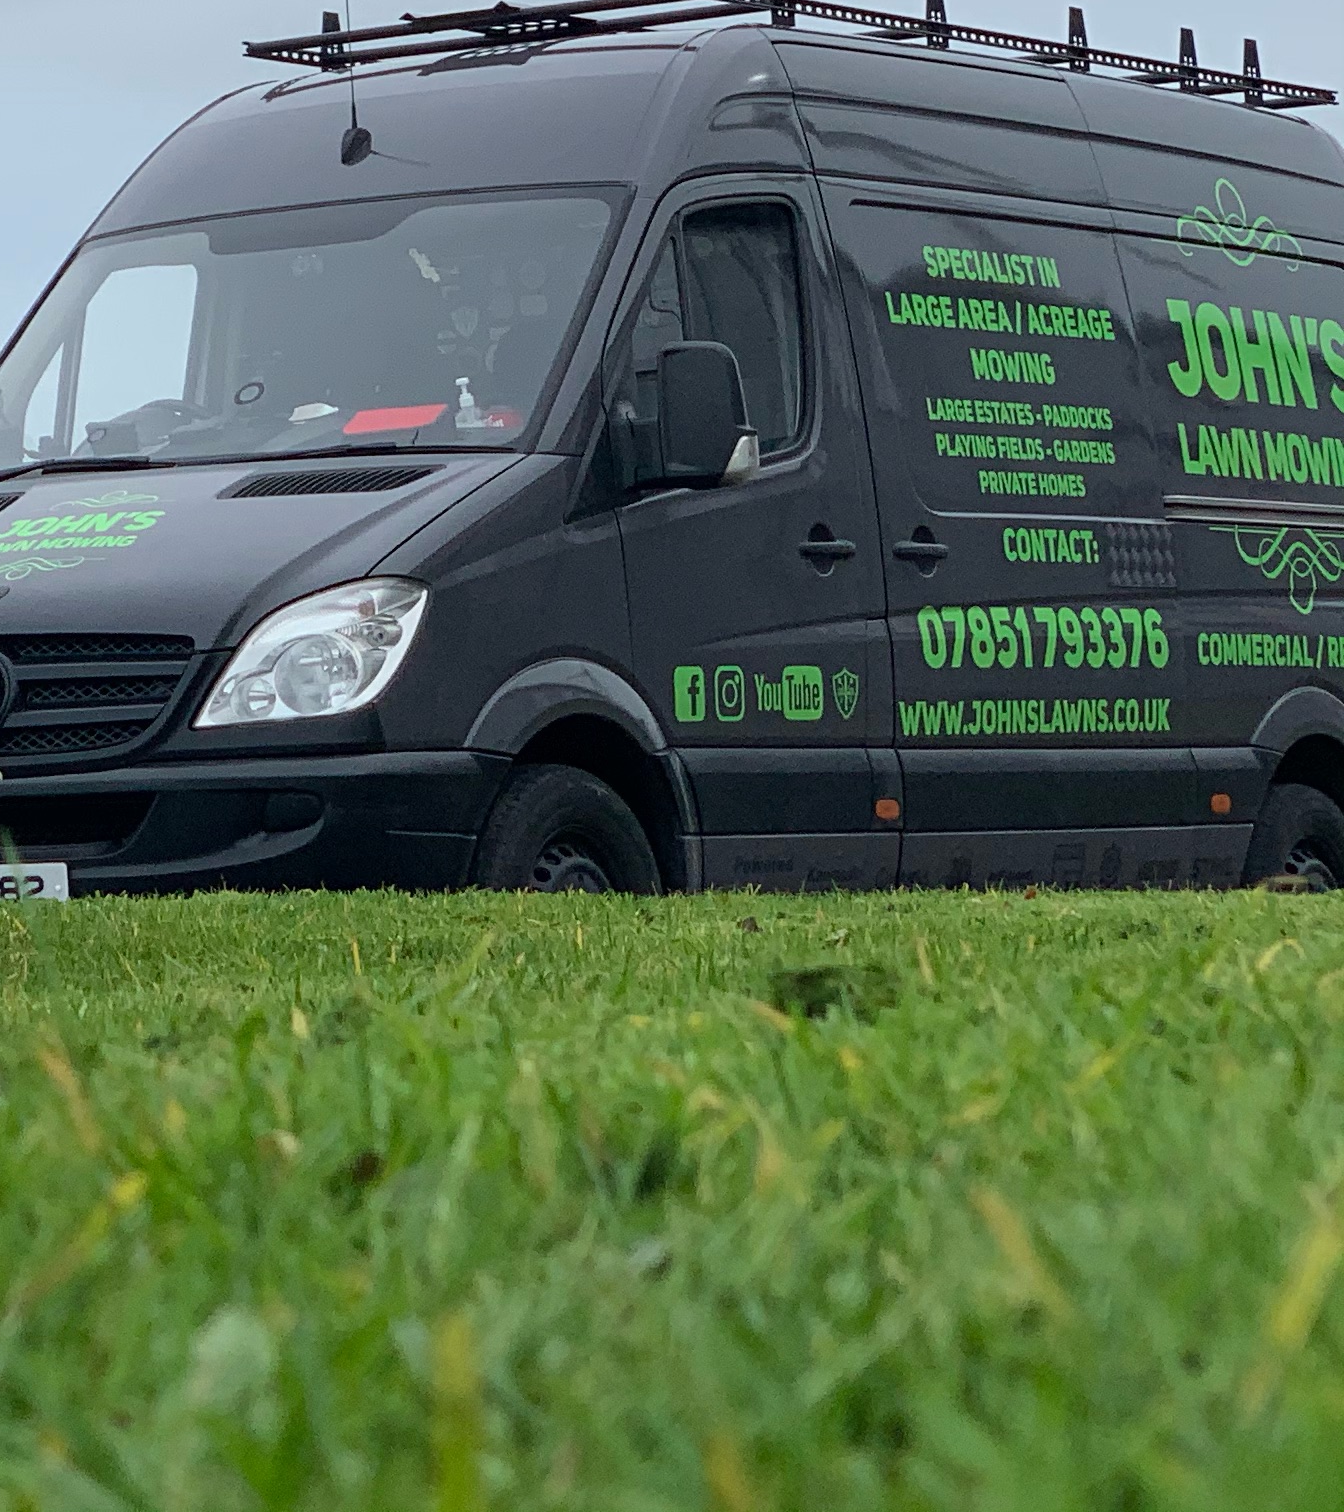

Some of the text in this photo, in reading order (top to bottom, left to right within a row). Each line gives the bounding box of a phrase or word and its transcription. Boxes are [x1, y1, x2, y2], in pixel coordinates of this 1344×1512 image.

[922, 245, 1061, 288] SPECIALIST IN
[884, 291, 956, 328] LARGE
[958, 297, 1013, 333] AREA
[1028, 303, 1116, 341] ACREAGE
[969, 347, 1056, 386] MOWING
[1166, 298, 1344, 414] JOHN'S
[926, 397, 974, 423] LARGE
[974, 400, 1035, 426] ESTATES
[1042, 404, 1113, 431] PADDOCKS
[935, 432, 996, 459] PLAYING
[997, 436, 1045, 461] FIELDS
[1053, 439, 1116, 464] GARDENS
[1177, 422, 1344, 487] LAWN MOWI
[978, 470, 1087, 497] PRIVATE HOMES
[35, 535, 138, 550] MOWING
[1003, 527, 1100, 564] CONTACT:
[1197, 632, 1314, 667] COMMERCIAL
[754, 672, 822, 713] YouTube
[898, 698, 1170, 736] WWW.JOHNSLAWNS.CO.UK
